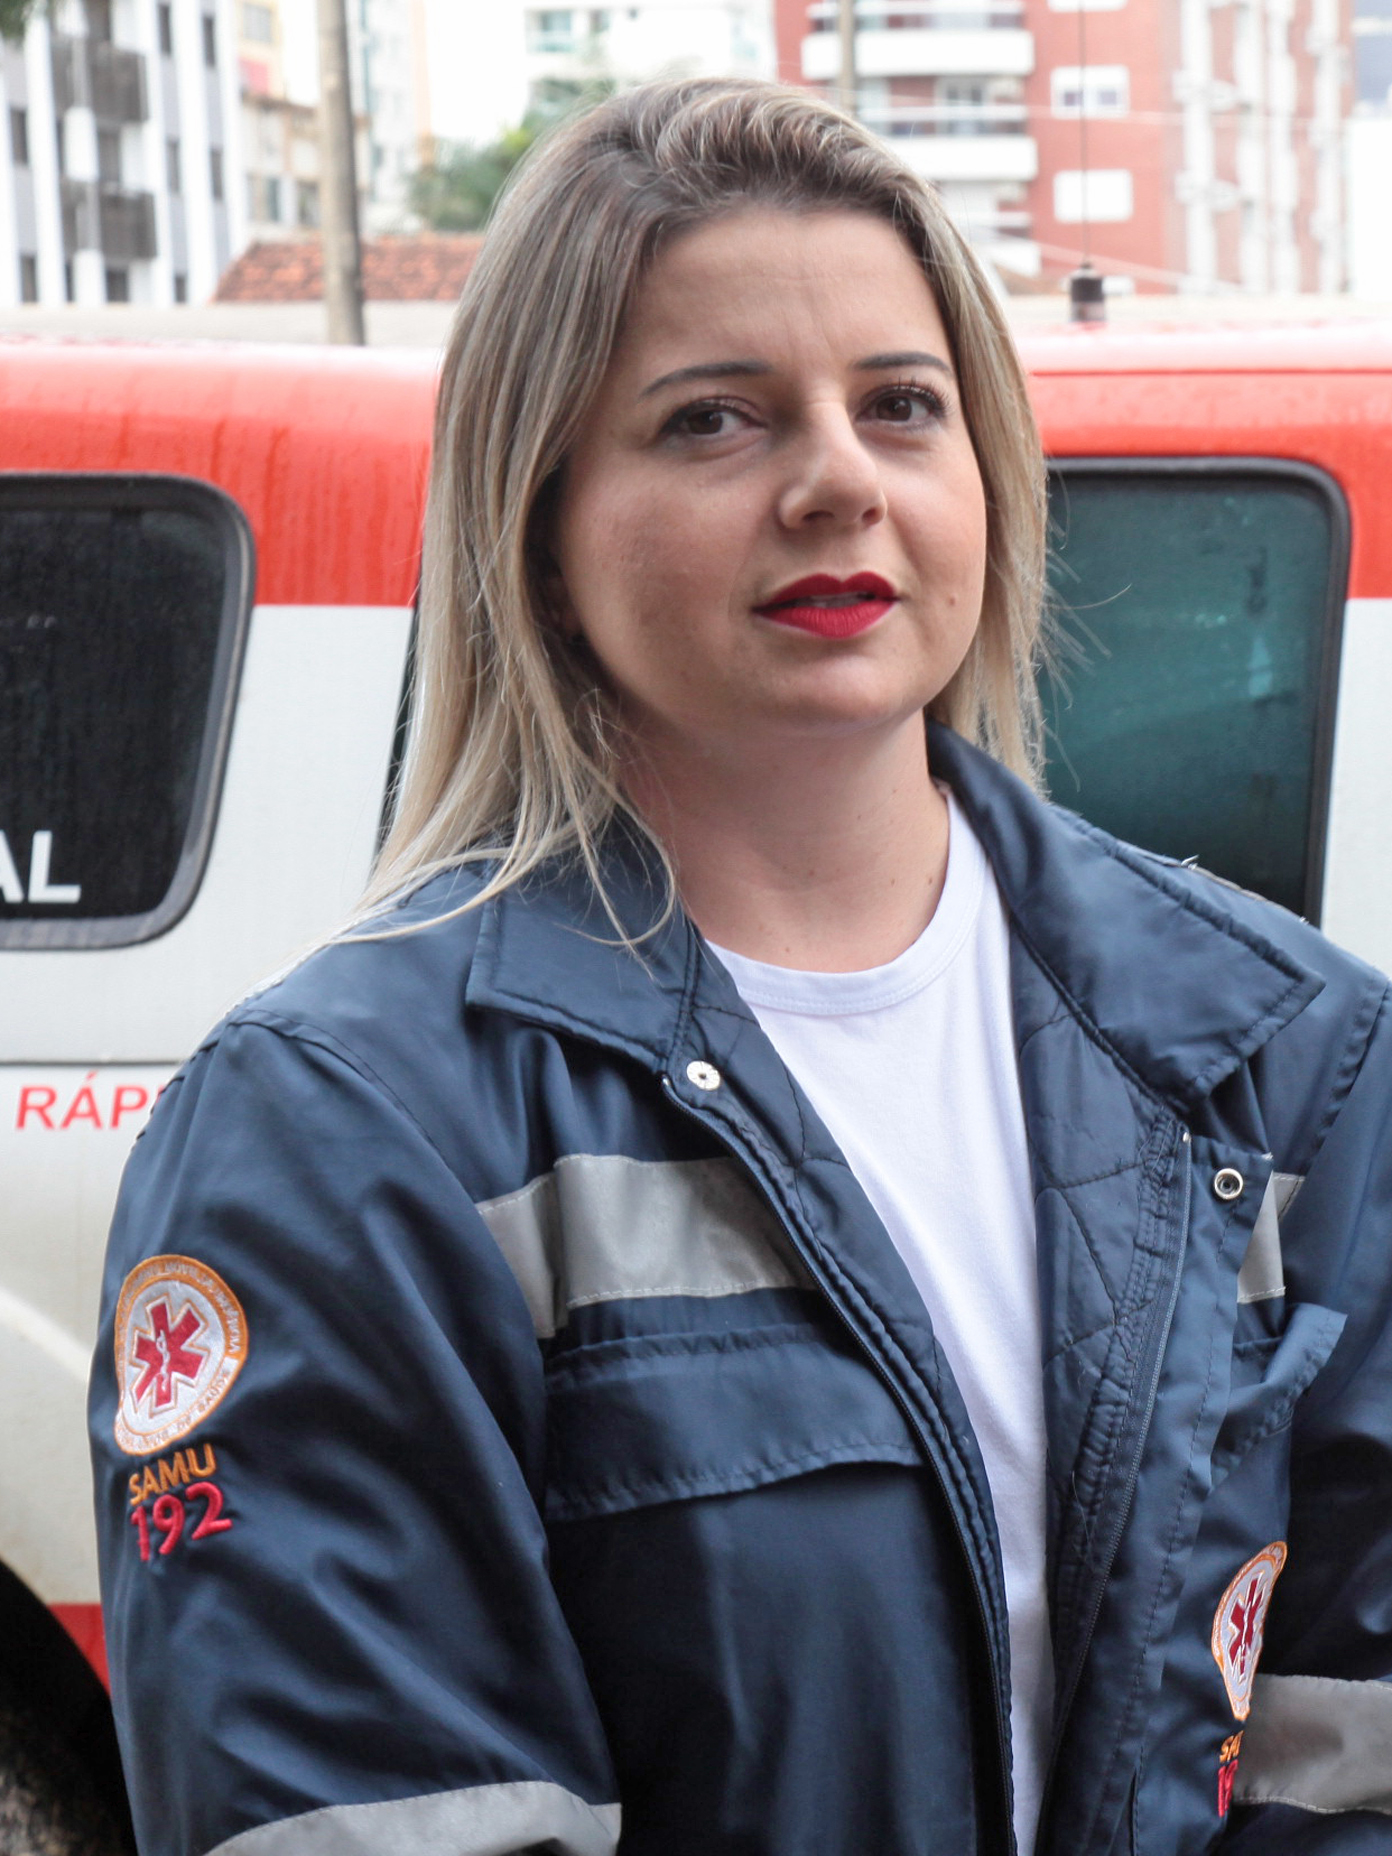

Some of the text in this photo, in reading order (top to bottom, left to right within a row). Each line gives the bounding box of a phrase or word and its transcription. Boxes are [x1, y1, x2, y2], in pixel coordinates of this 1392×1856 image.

[15, 1069, 166, 1131] RÁP
[129, 1443, 217, 1506] SAMU
[130, 1481, 233, 1562] 192
